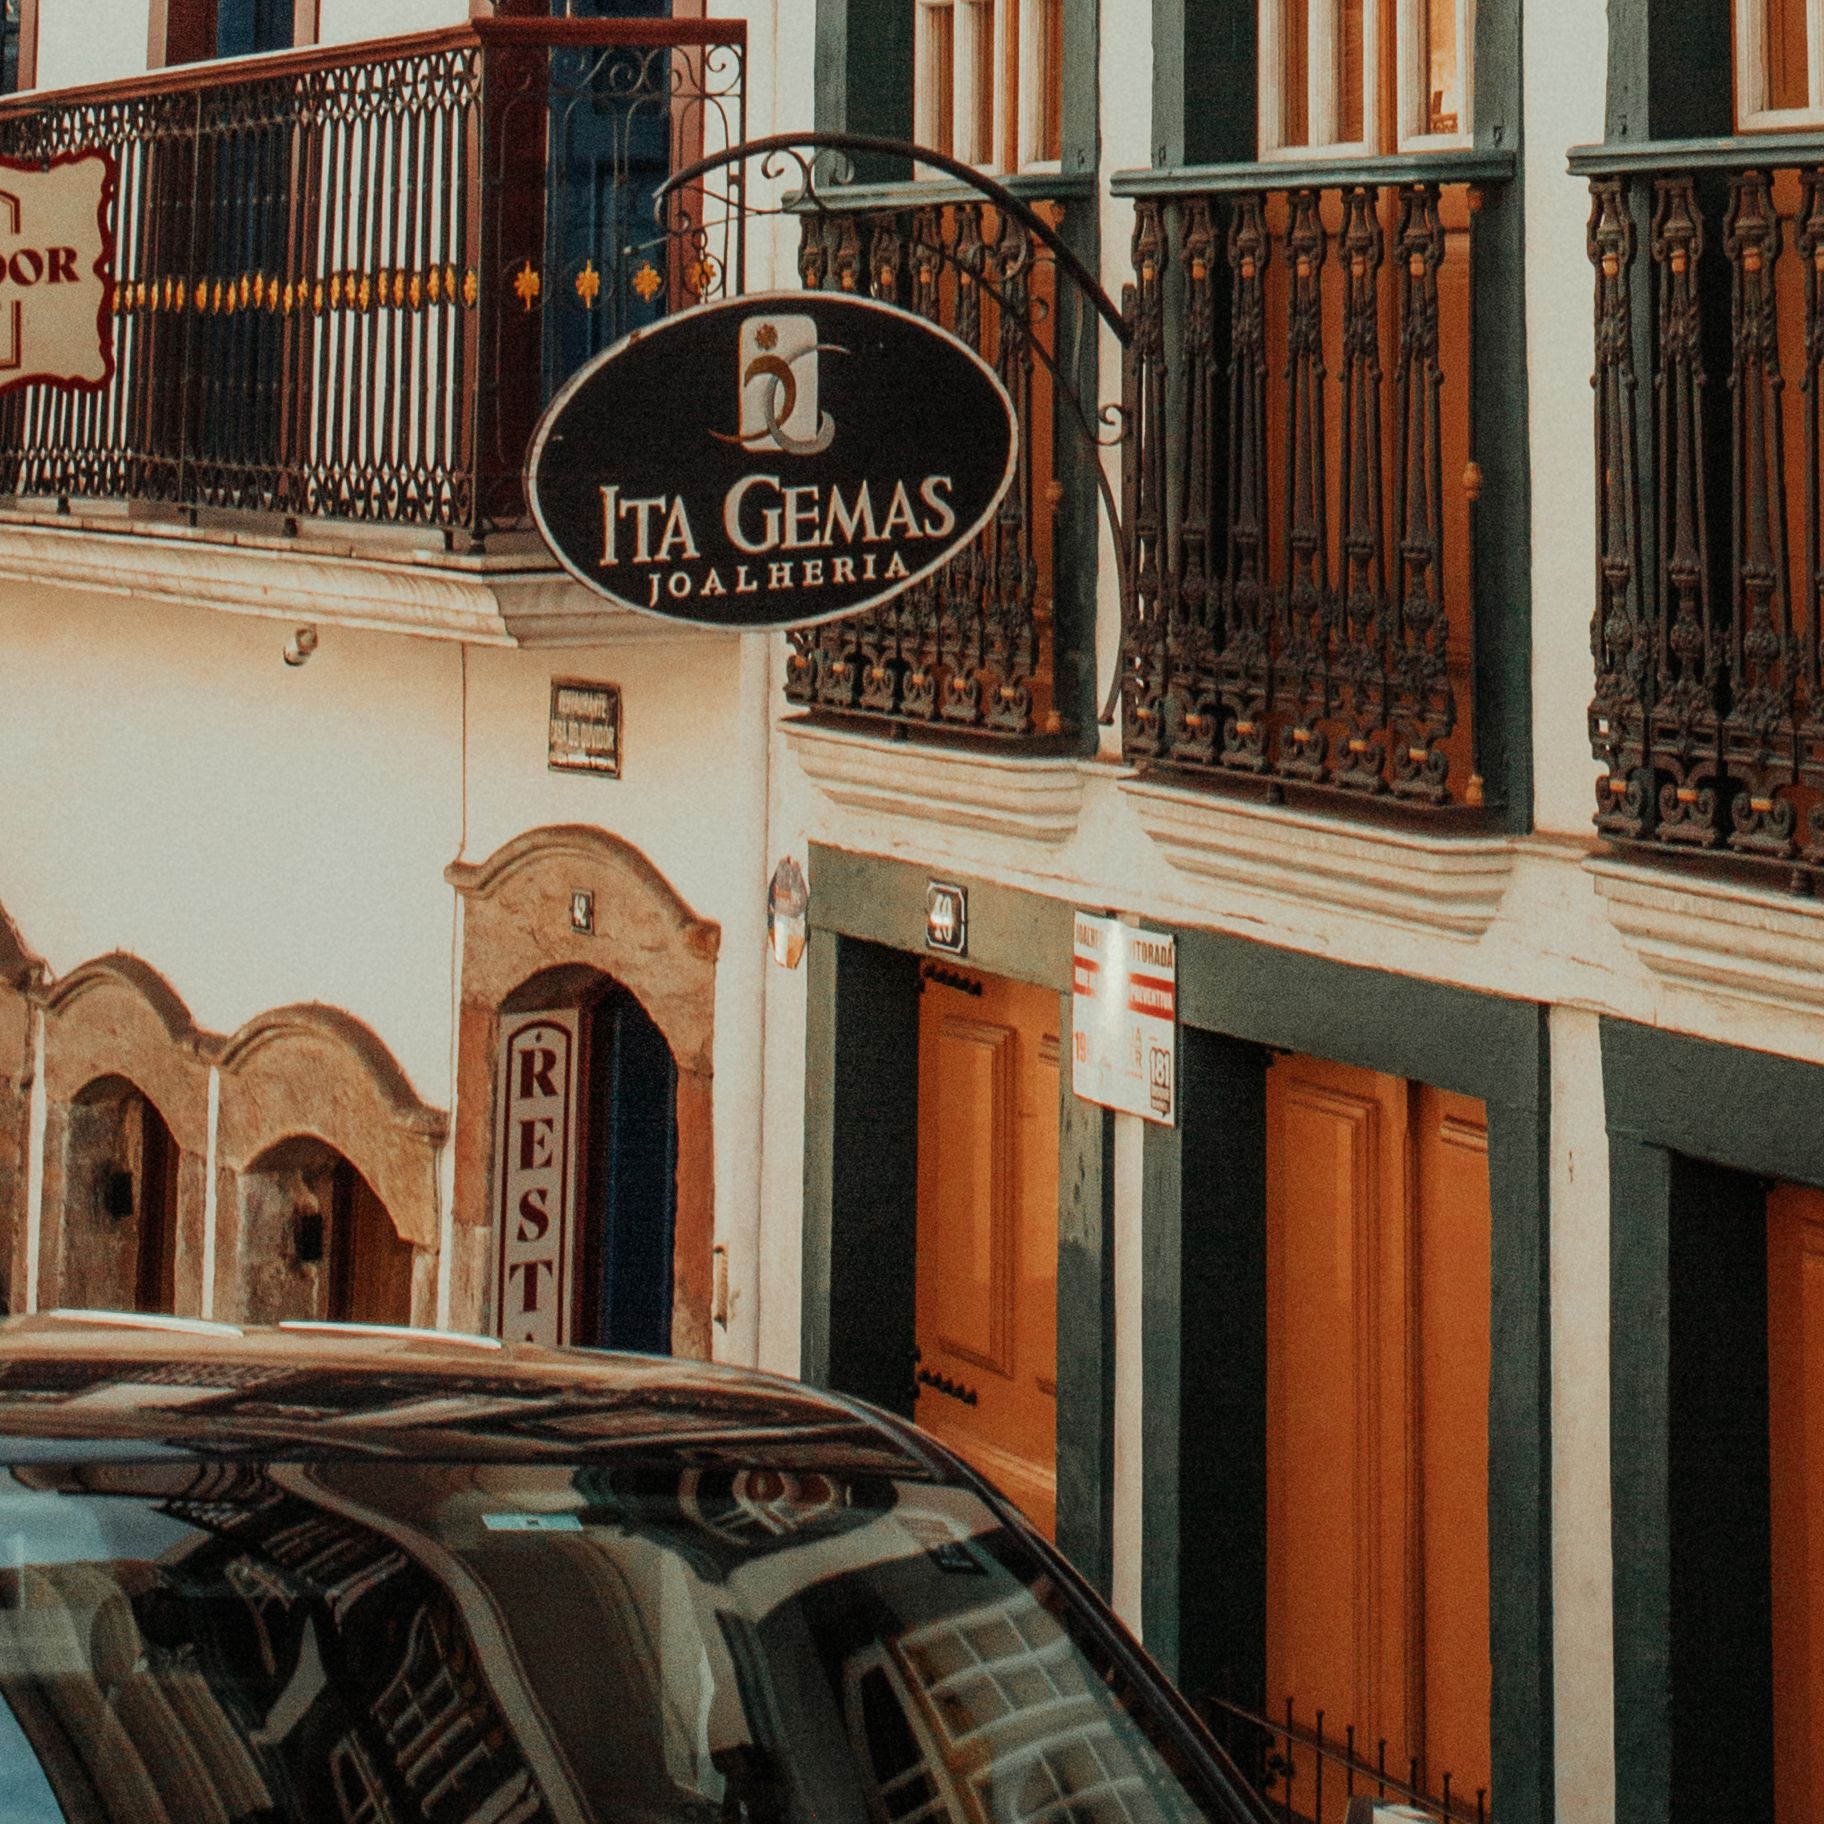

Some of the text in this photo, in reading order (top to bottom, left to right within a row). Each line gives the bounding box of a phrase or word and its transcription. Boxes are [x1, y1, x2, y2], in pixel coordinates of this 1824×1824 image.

[600, 472, 956, 568] ITA GEMAS
[648, 551, 912, 608] JOALHERIA
[508, 1047, 559, 1343] REST
